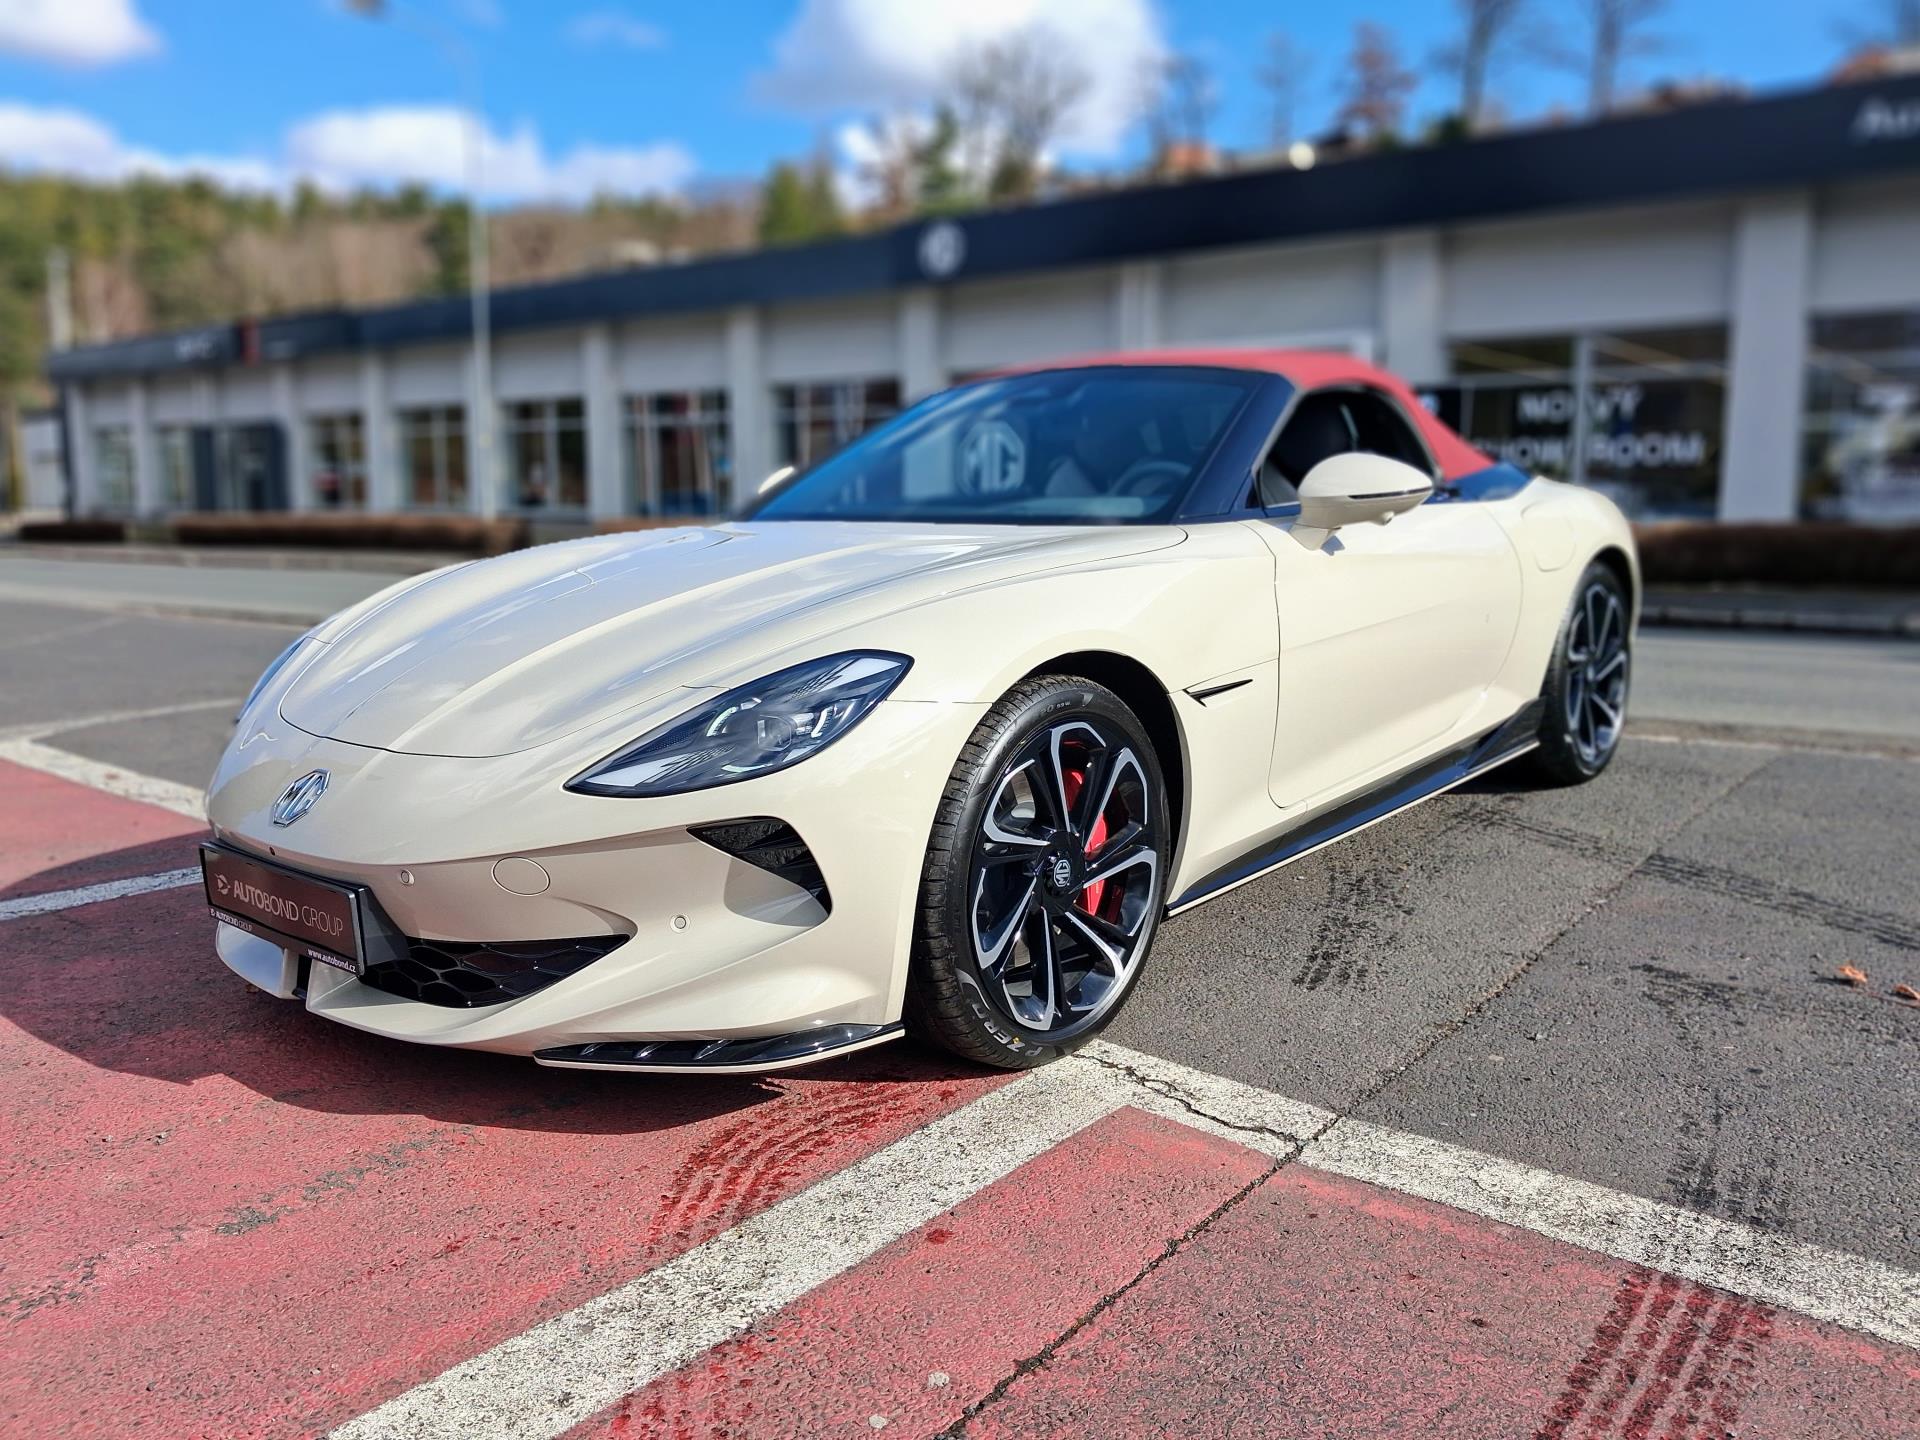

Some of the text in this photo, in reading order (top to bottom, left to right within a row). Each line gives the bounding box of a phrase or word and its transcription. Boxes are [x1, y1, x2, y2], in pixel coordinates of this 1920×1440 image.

[1054, 860, 1071, 887] MG
[233, 879, 343, 937] AUTOBOND GROUP
[307, 948, 357, 973] www.autobond.cz
